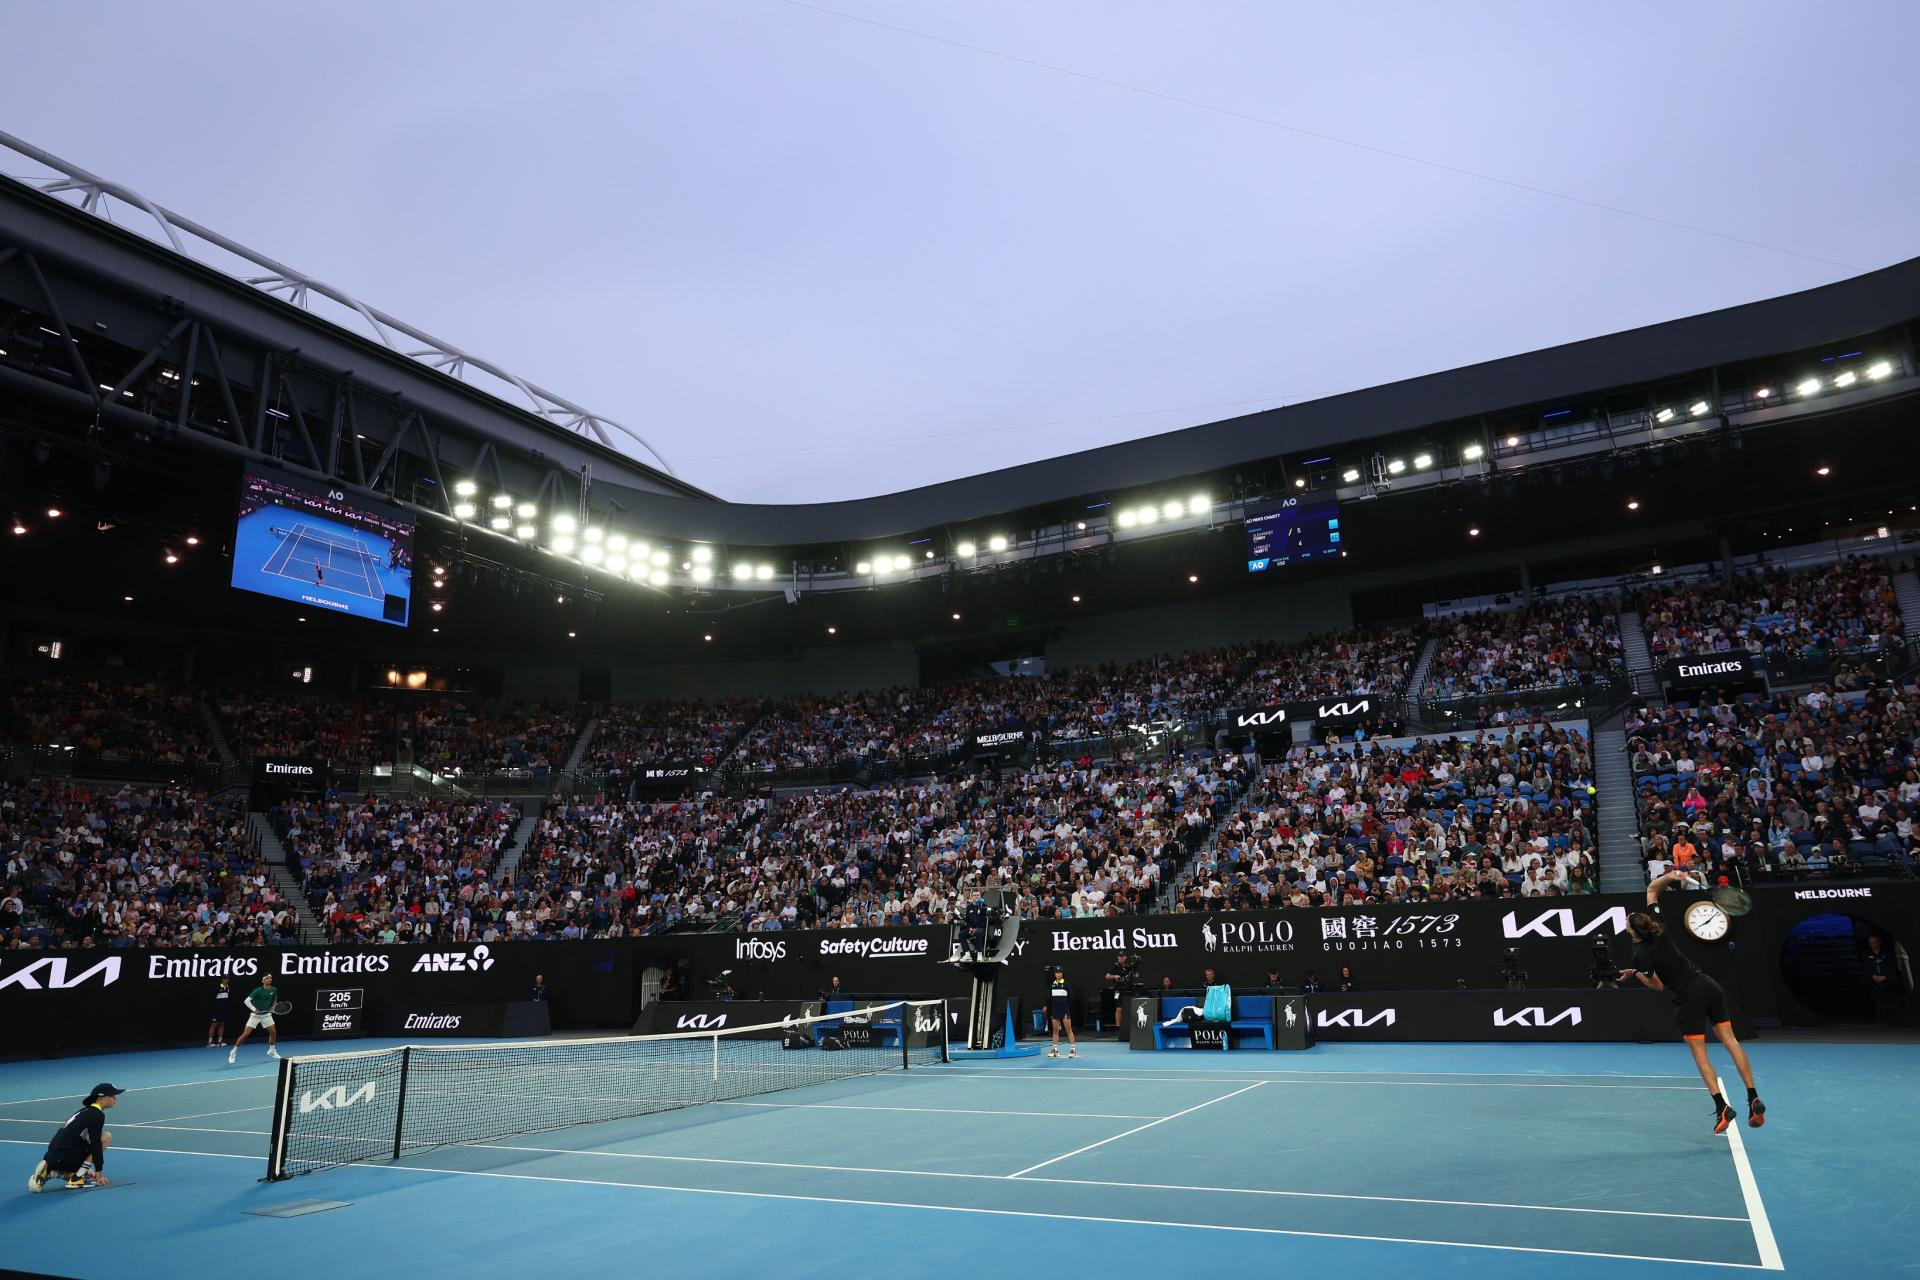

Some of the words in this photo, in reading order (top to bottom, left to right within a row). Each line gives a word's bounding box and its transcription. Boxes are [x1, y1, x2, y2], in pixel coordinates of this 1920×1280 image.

[328, 489, 344, 500] AO
[1282, 498, 1297, 507] AO
[1252, 562, 1264, 570] AO
[302, 595, 349, 610] MELBOURNE
[1678, 661, 1742, 677] Emirates
[1319, 700, 1370, 718] KIA
[1237, 709, 1286, 727] KIA
[976, 731, 1024, 743] MELBOURNE
[266, 763, 313, 775] Emirates
[1794, 887, 1872, 900] MELBOURNE
[1382, 914, 1459, 936] 1573
[1502, 906, 1627, 938] KIA
[1052, 929, 1126, 951] Herald
[1132, 928, 1178, 949] Sun
[1221, 919, 1293, 944] POLO
[736, 937, 786, 962] Infosys
[819, 936, 929, 957] SafetyCulture
[1223, 945, 1253, 953] RALPH
[1258, 943, 1294, 952] LAUREN
[1323, 940, 1403, 951] GUOJIAO
[1419, 938, 1462, 948] 1573
[148, 953, 258, 978] Emirates
[281, 951, 390, 975] Emirates
[411, 952, 467, 972] ANZ
[329, 992, 351, 1002] 205
[324, 1013, 351, 1022] Safety
[404, 1012, 462, 1029] Emirates
[676, 1014, 727, 1029] KIA
[1317, 1008, 1396, 1028] KIA
[1493, 1006, 1582, 1026] KIA
[322, 1021, 352, 1029] Culture
[843, 1029, 869, 1039] POLO
[1194, 1029, 1227, 1040] POLO
[300, 1081, 376, 1113] KIA
